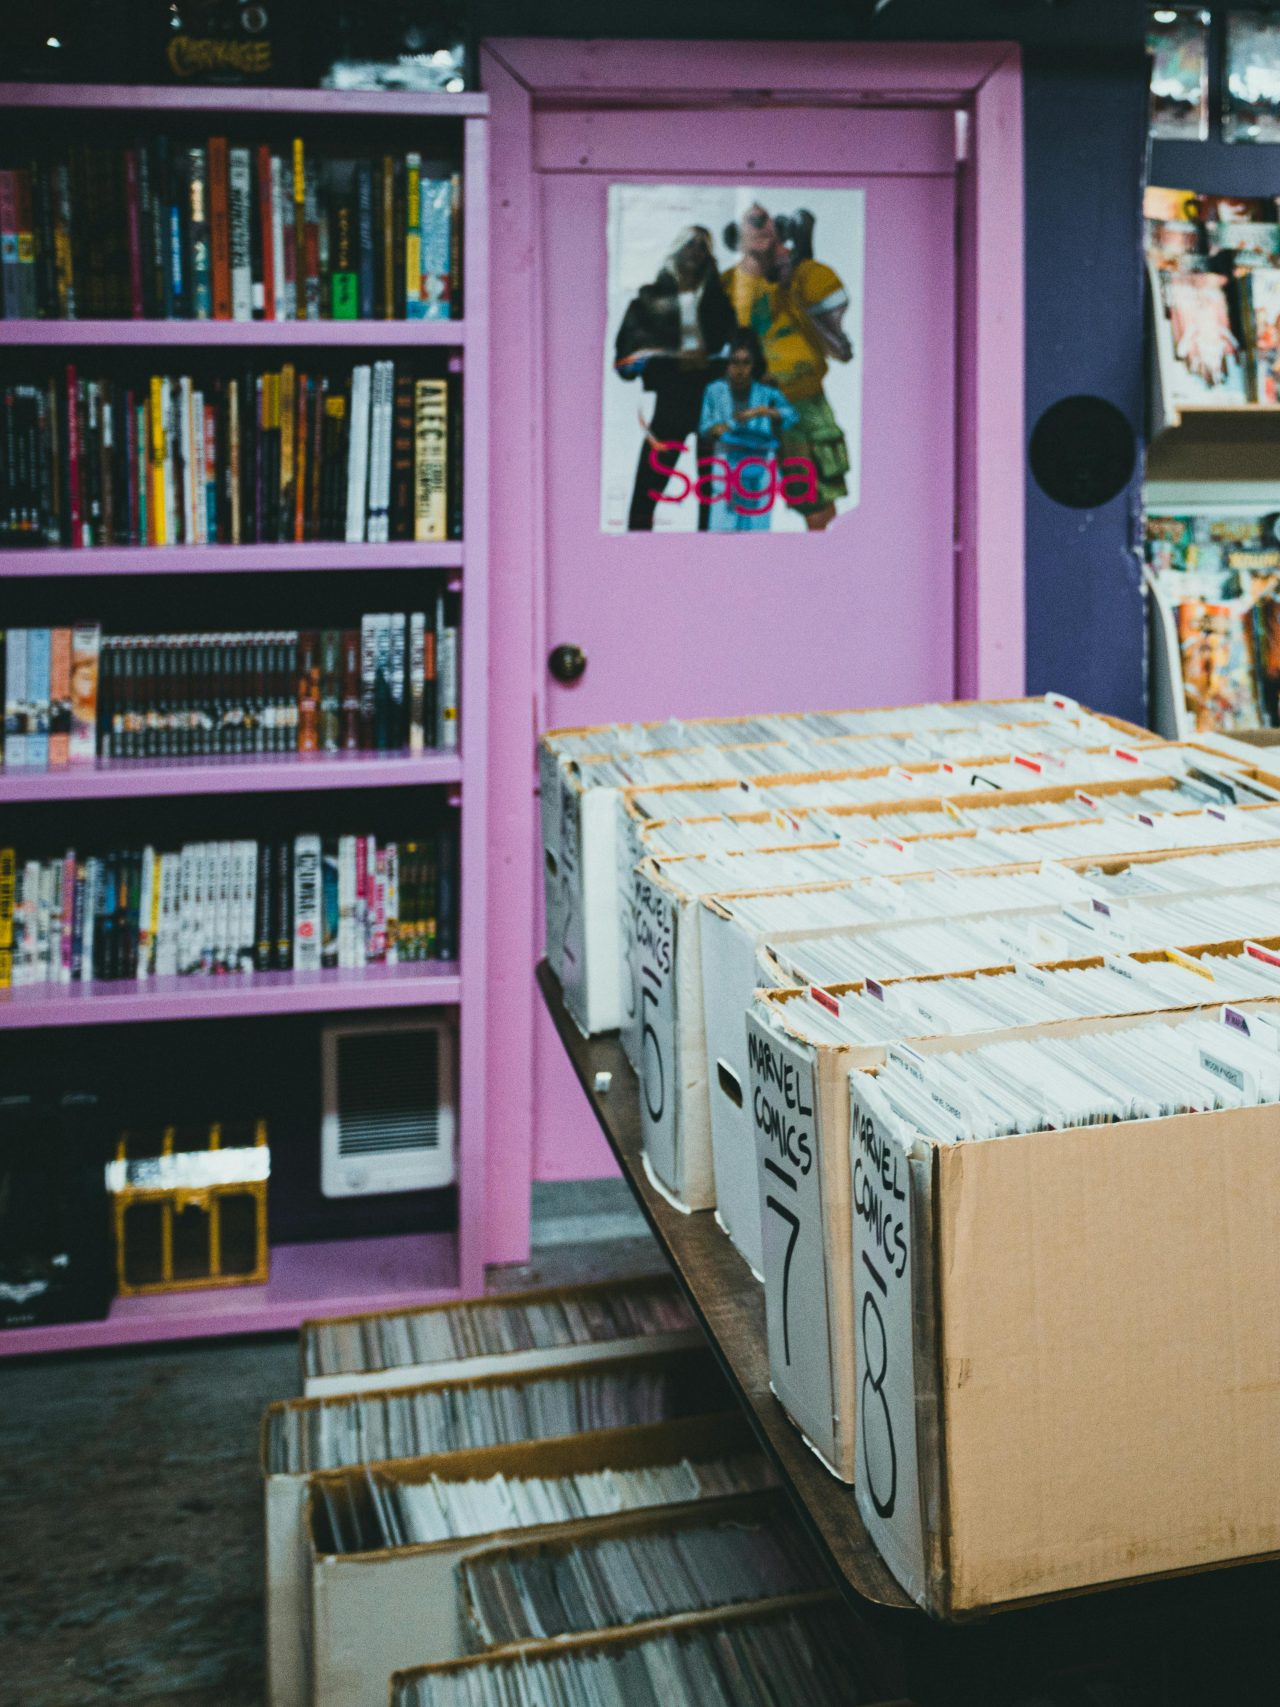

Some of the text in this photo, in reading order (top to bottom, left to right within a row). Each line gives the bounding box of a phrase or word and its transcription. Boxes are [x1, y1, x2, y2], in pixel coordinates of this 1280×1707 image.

[647, 440, 818, 516] Saga
[636, 910, 670, 974] COMICS
[748, 1032, 813, 1117] MARVEL
[753, 1086, 812, 1175] COMICS
[852, 1102, 906, 1202] MARVEL
[853, 1158, 907, 1279] COMICS
